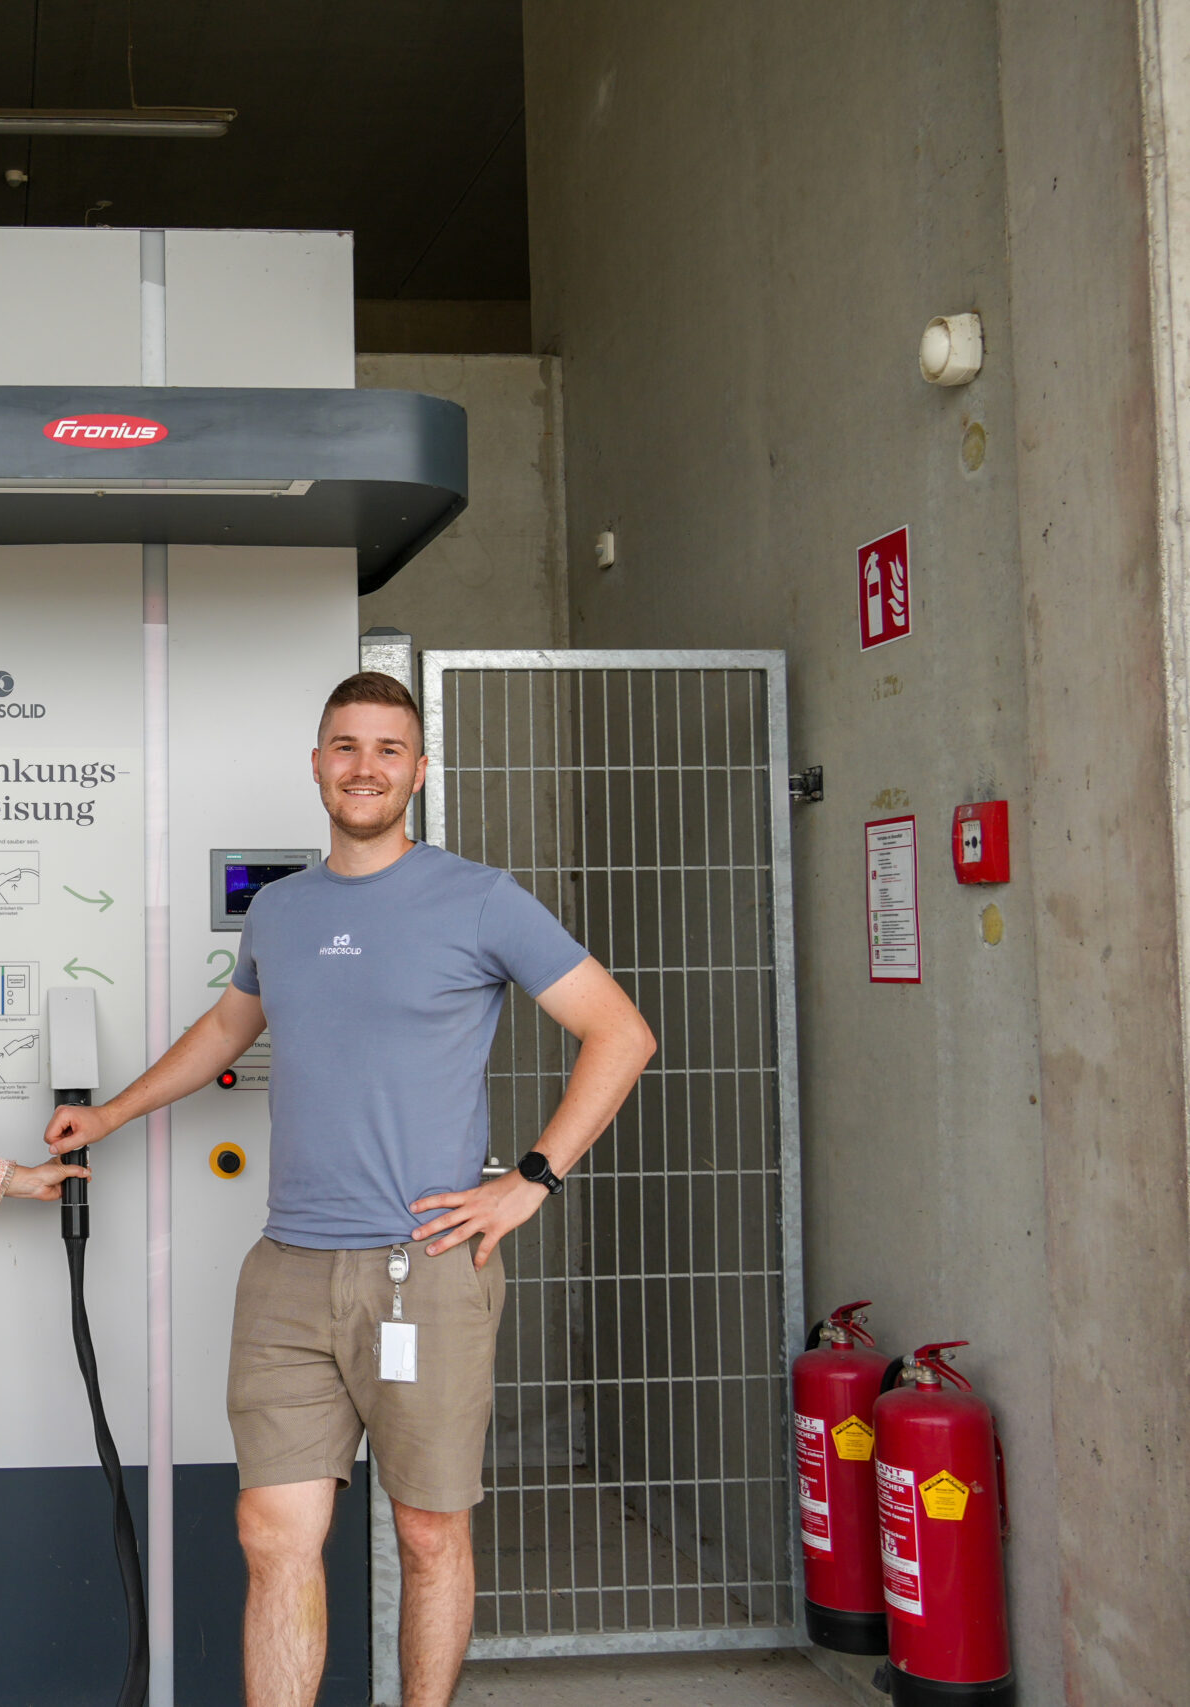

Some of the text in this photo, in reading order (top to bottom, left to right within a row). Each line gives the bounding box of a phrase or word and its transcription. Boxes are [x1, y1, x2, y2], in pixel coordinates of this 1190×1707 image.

[53, 420, 159, 439] Fronius
[319, 946, 362, 955] HYDROSOLID
[206, 949, 236, 988] 2
[795, 1413, 815, 1425] ANT
